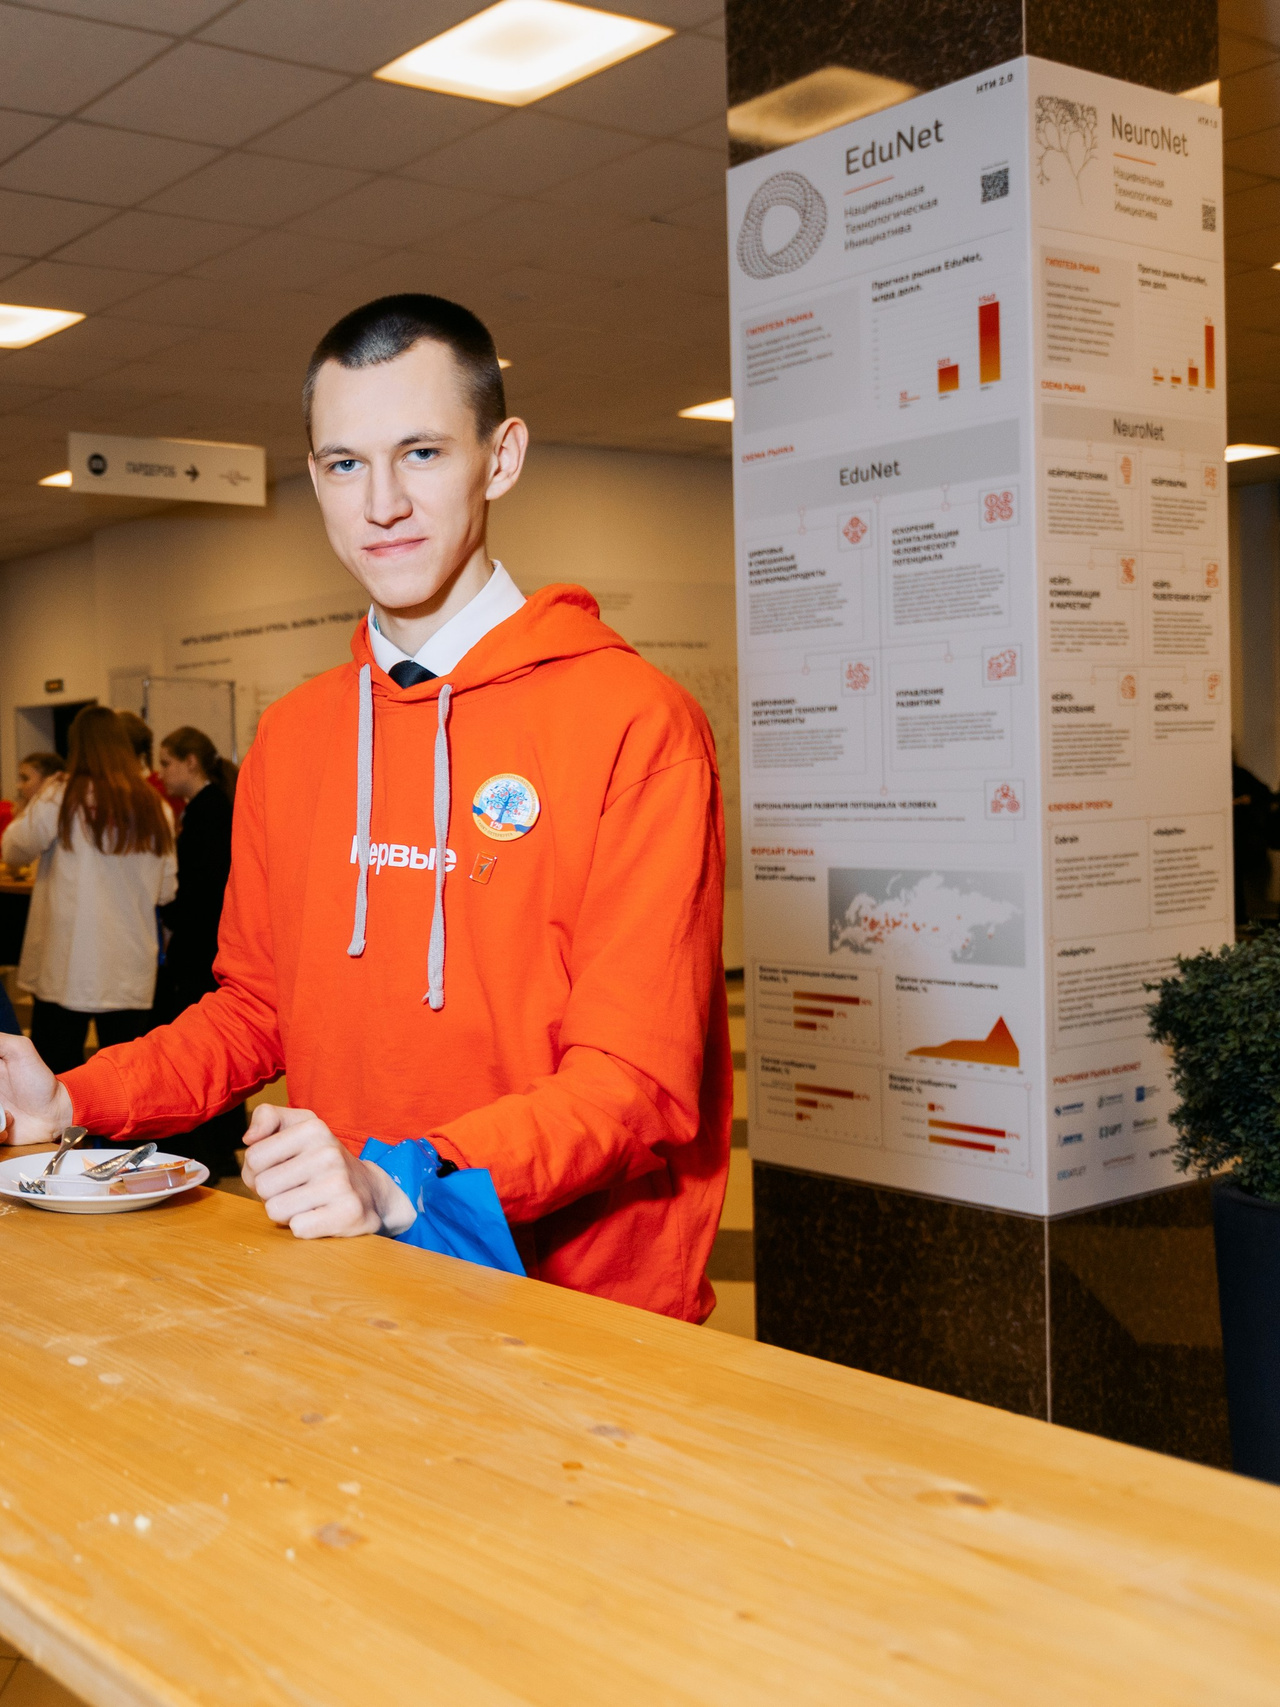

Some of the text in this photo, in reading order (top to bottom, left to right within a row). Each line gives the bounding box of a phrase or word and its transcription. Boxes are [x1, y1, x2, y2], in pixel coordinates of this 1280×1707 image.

[845, 118, 944, 176] EduNet
[1111, 113, 1189, 157] NeuroNet
[844, 184, 925, 219] Национальная
[845, 198, 939, 236] Технологическая
[844, 223, 912, 252] Инициатива
[1113, 418, 1165, 442] NeuroNet
[838, 459, 902, 487] EduNet
